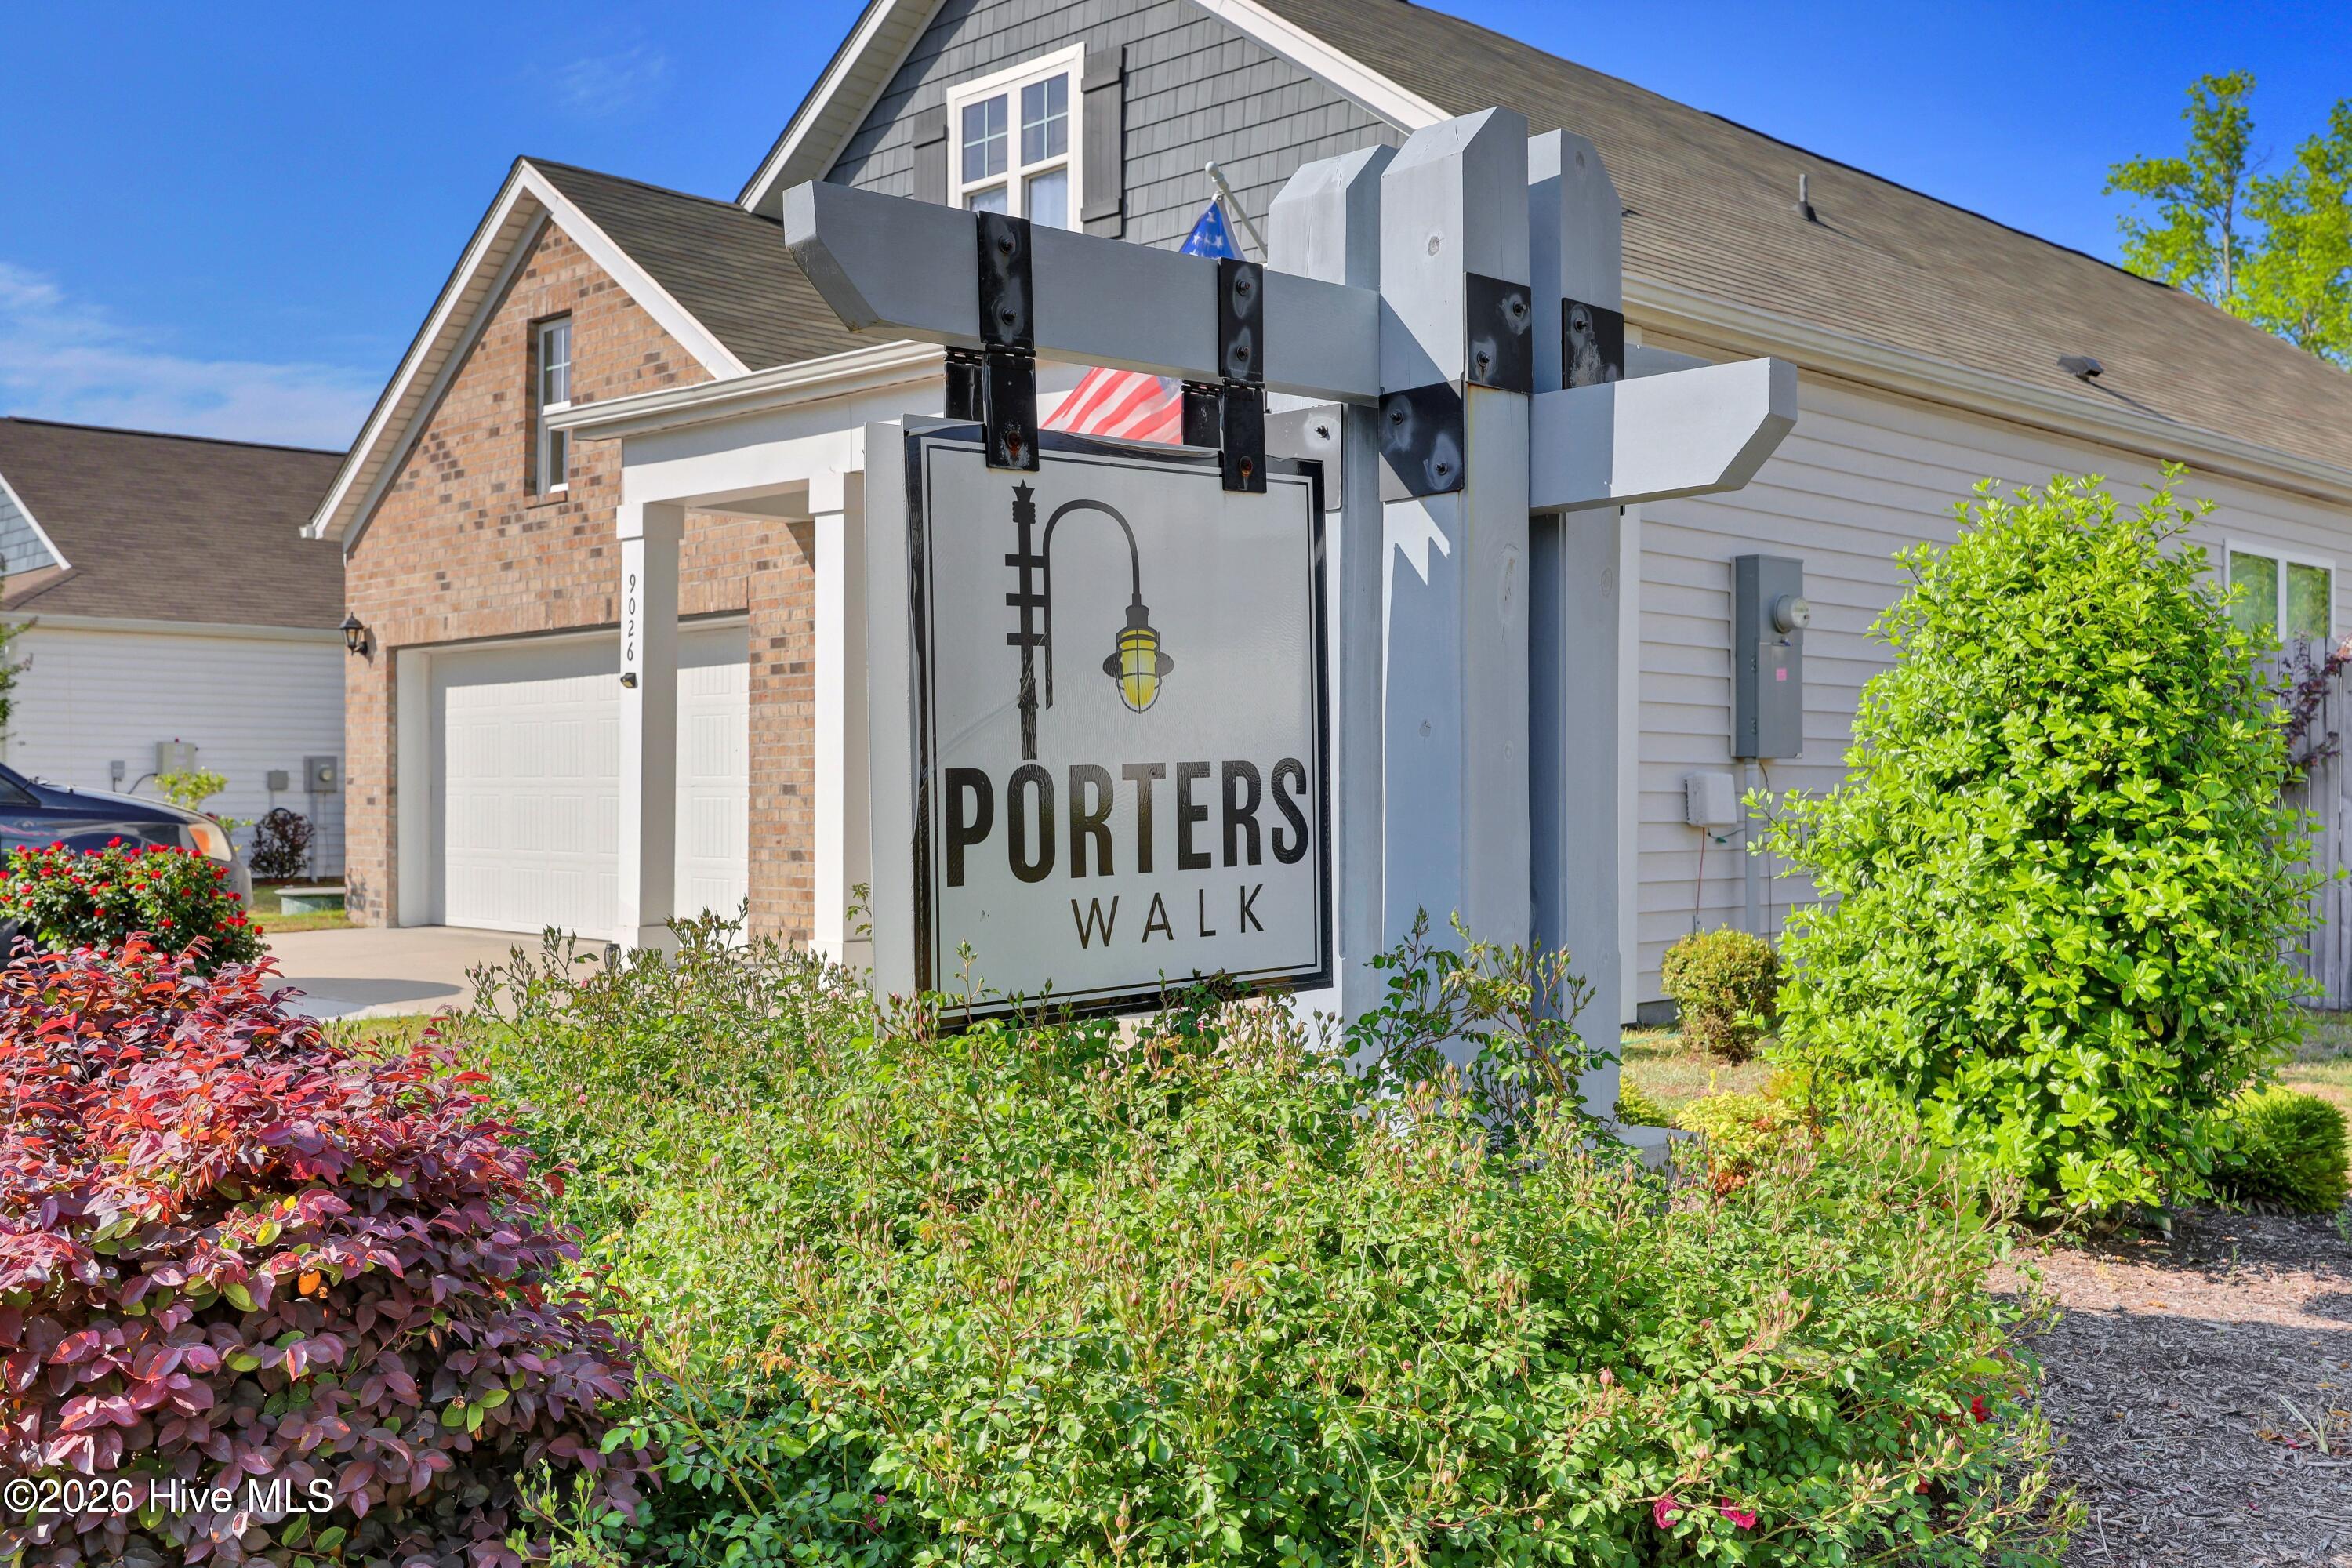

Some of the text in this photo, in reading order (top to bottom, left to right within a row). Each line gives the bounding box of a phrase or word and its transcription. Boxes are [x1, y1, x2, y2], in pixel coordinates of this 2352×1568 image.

[626, 574, 637, 662] 9026
[945, 757, 1308, 887] PORTERS
[1070, 884, 1265, 949] WALK
